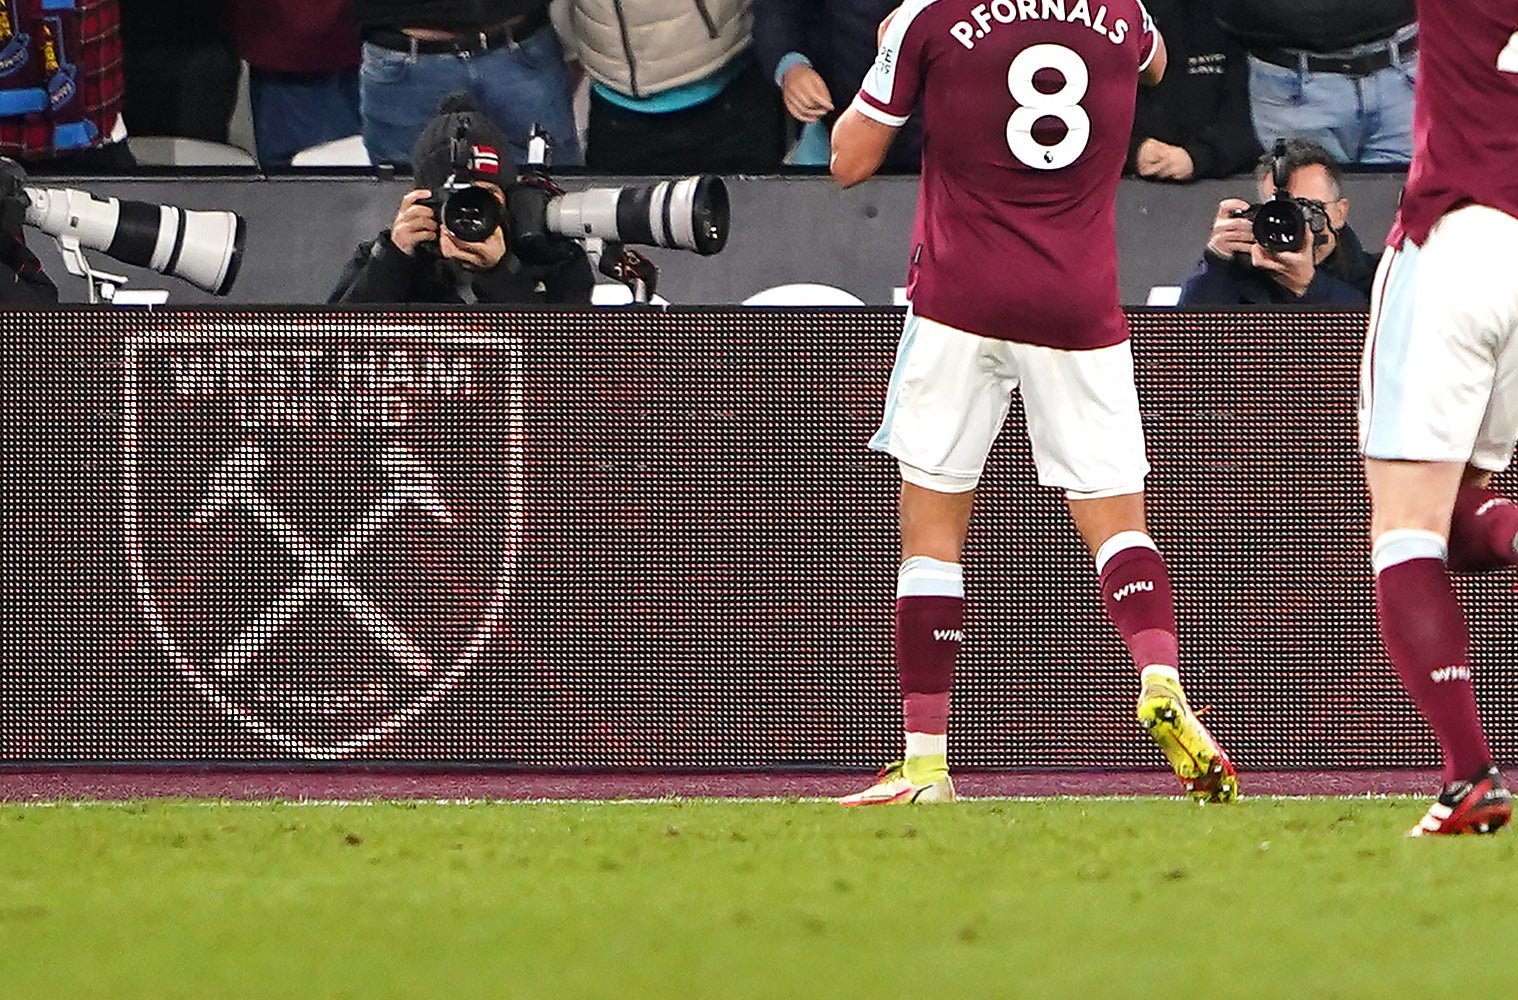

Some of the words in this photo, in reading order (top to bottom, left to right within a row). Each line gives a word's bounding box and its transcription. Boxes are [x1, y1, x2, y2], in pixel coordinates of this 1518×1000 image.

[1006, 43, 1091, 170] 8
[170, 348, 327, 398] WEST
[336, 347, 477, 398] HAM
[235, 394, 412, 430] UNITED
[1112, 580, 1154, 601] WHU
[933, 629, 963, 642] WH
